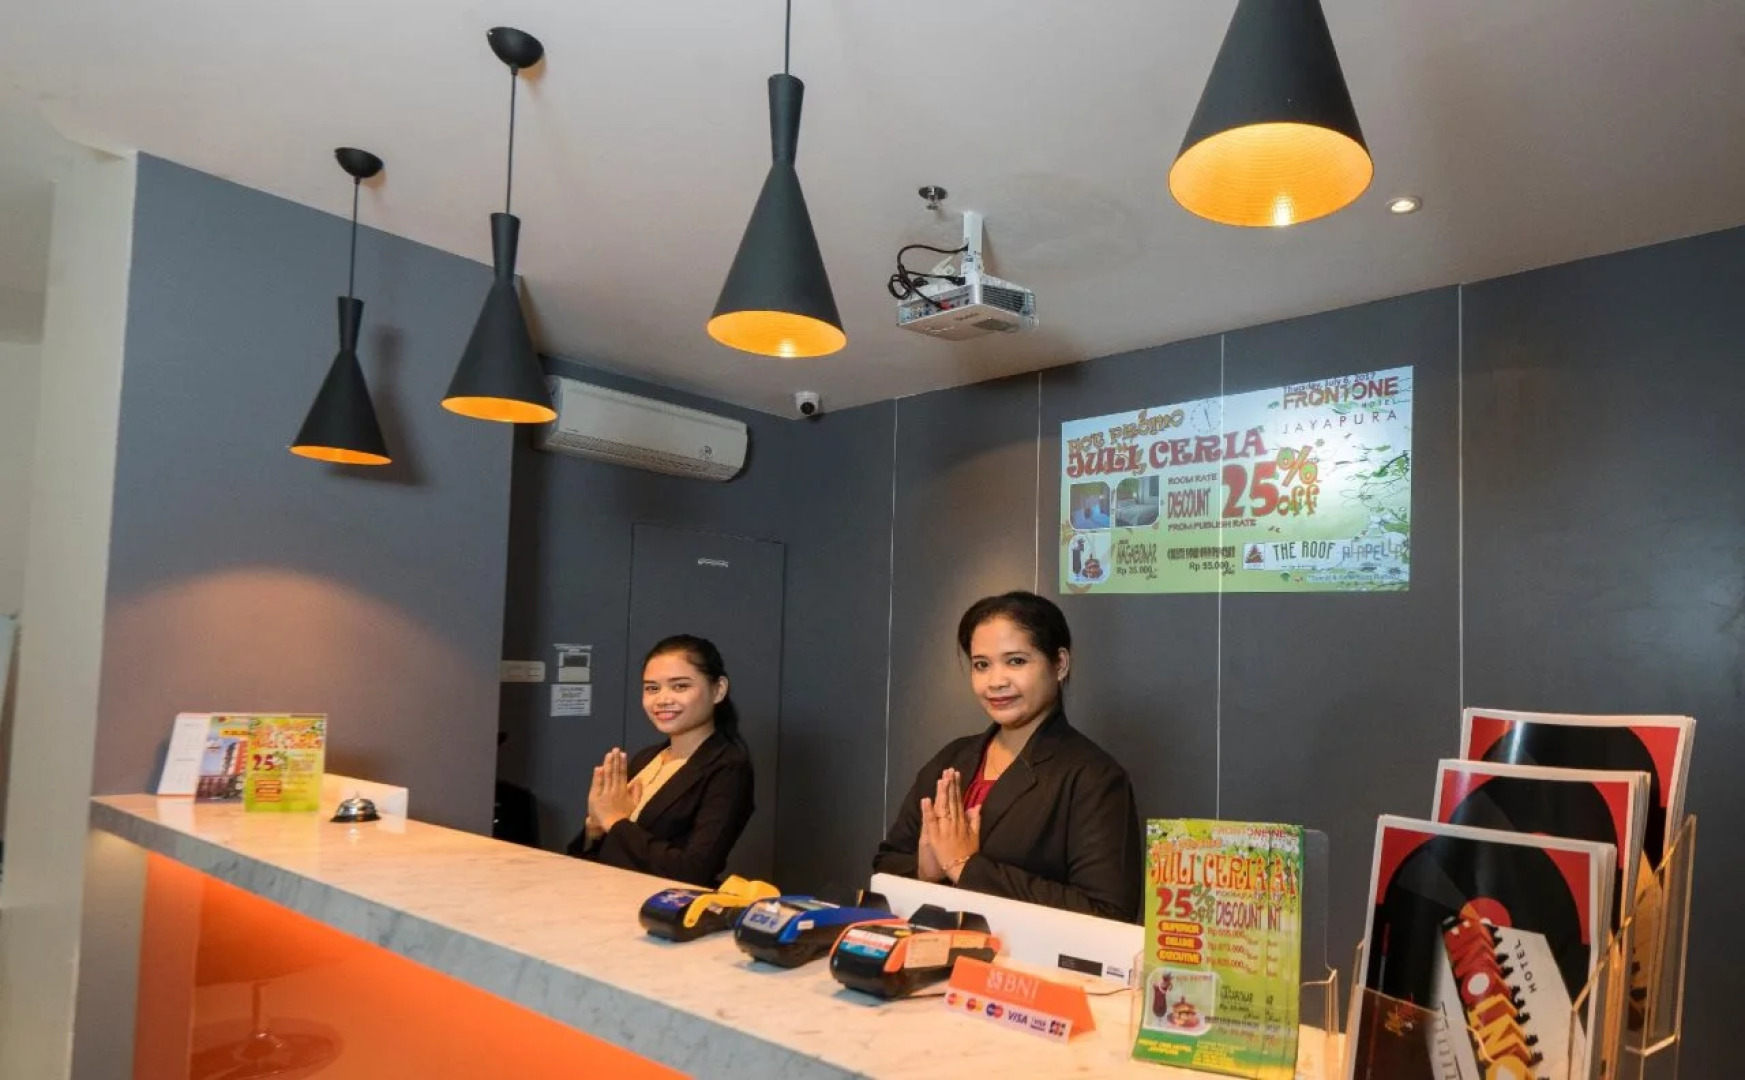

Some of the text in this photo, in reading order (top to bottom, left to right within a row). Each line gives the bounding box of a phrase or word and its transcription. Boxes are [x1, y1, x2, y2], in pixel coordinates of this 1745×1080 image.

[1282, 408, 1397, 435] JAYAPURA
[1066, 425, 1269, 479] JULI CERIA
[1195, 472, 1218, 483] RATE
[1167, 487, 1211, 519] DISCOUNT
[1277, 483, 1320, 517] off
[1168, 518, 1257, 532] FROM PUBLISH RATE
[1272, 540, 1336, 561] THE ROOF
[1188, 562, 1200, 571] Rp
[1203, 852, 1266, 892] CERIA
[1215, 899, 1262, 930] DISCOUNT
[1514, 939, 1537, 994] HOTEL
[1003, 973, 1040, 1001] BNI
[1008, 1010, 1028, 1025] VISA
